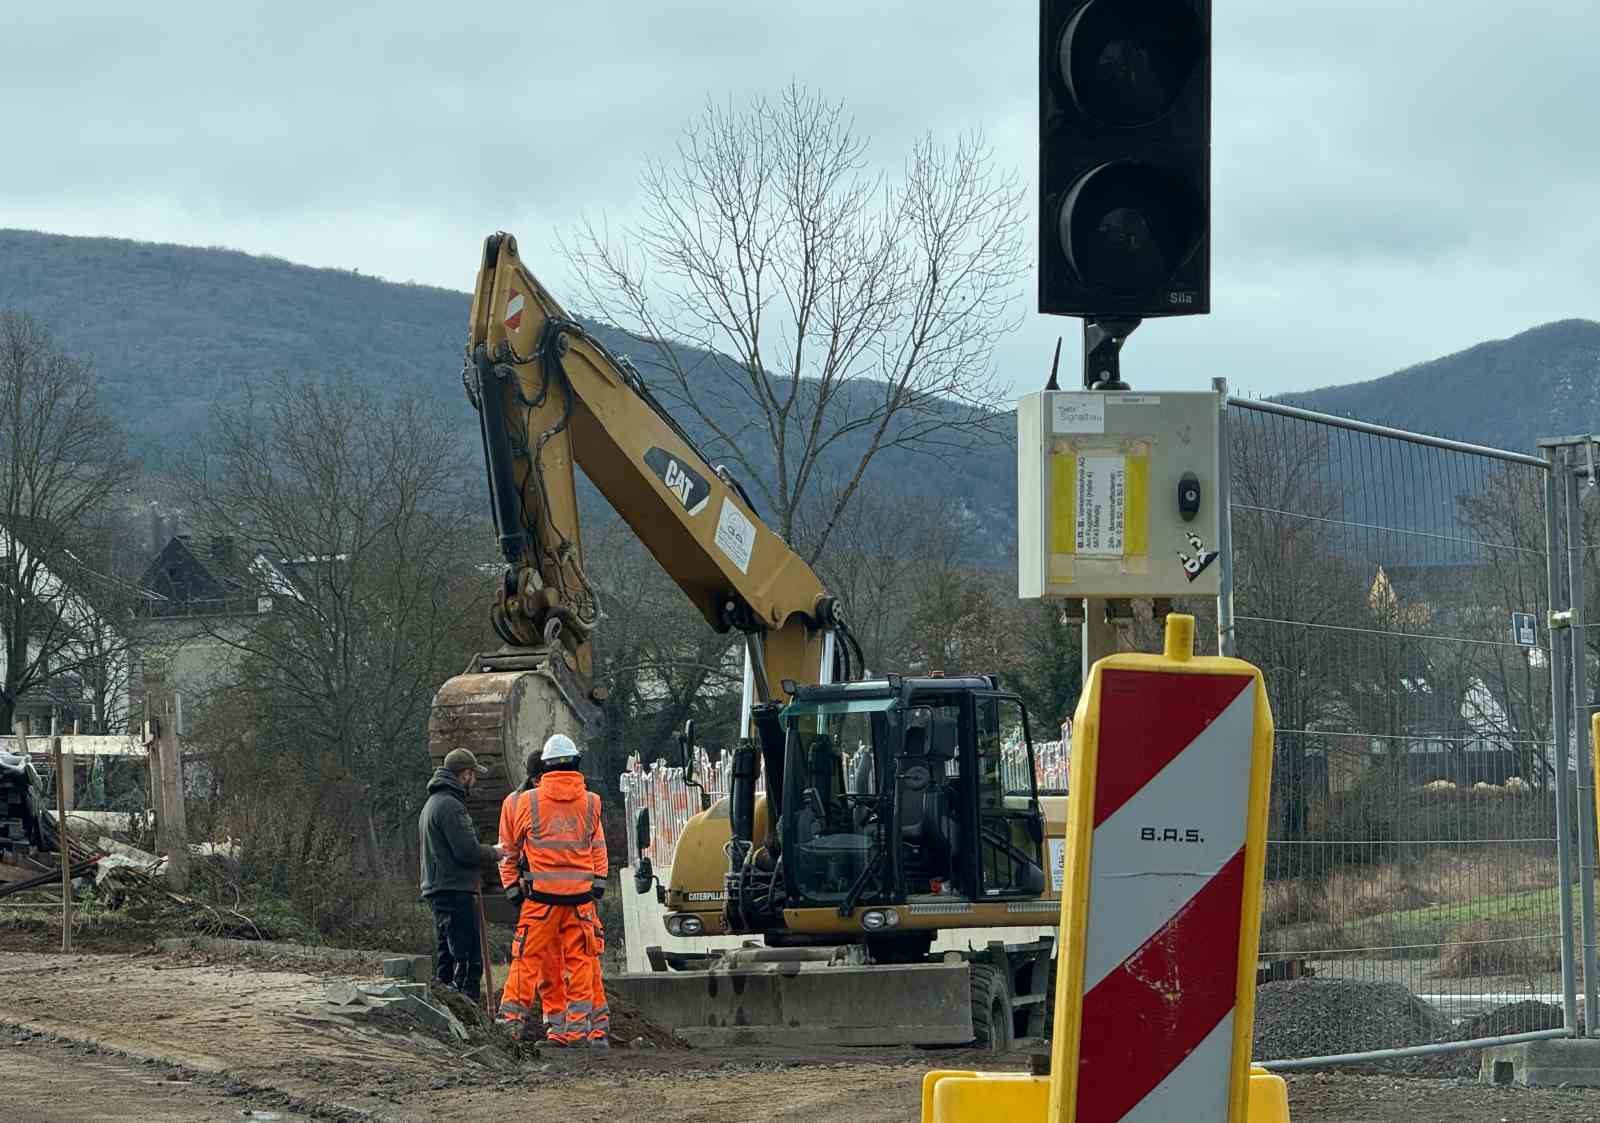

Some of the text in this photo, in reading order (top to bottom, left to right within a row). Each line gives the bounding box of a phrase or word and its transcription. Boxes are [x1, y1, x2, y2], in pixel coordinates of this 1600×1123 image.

[1169, 292, 1192, 304] Sila
[664, 459, 694, 506] CAT
[1141, 827, 1205, 844] B.A.S.
